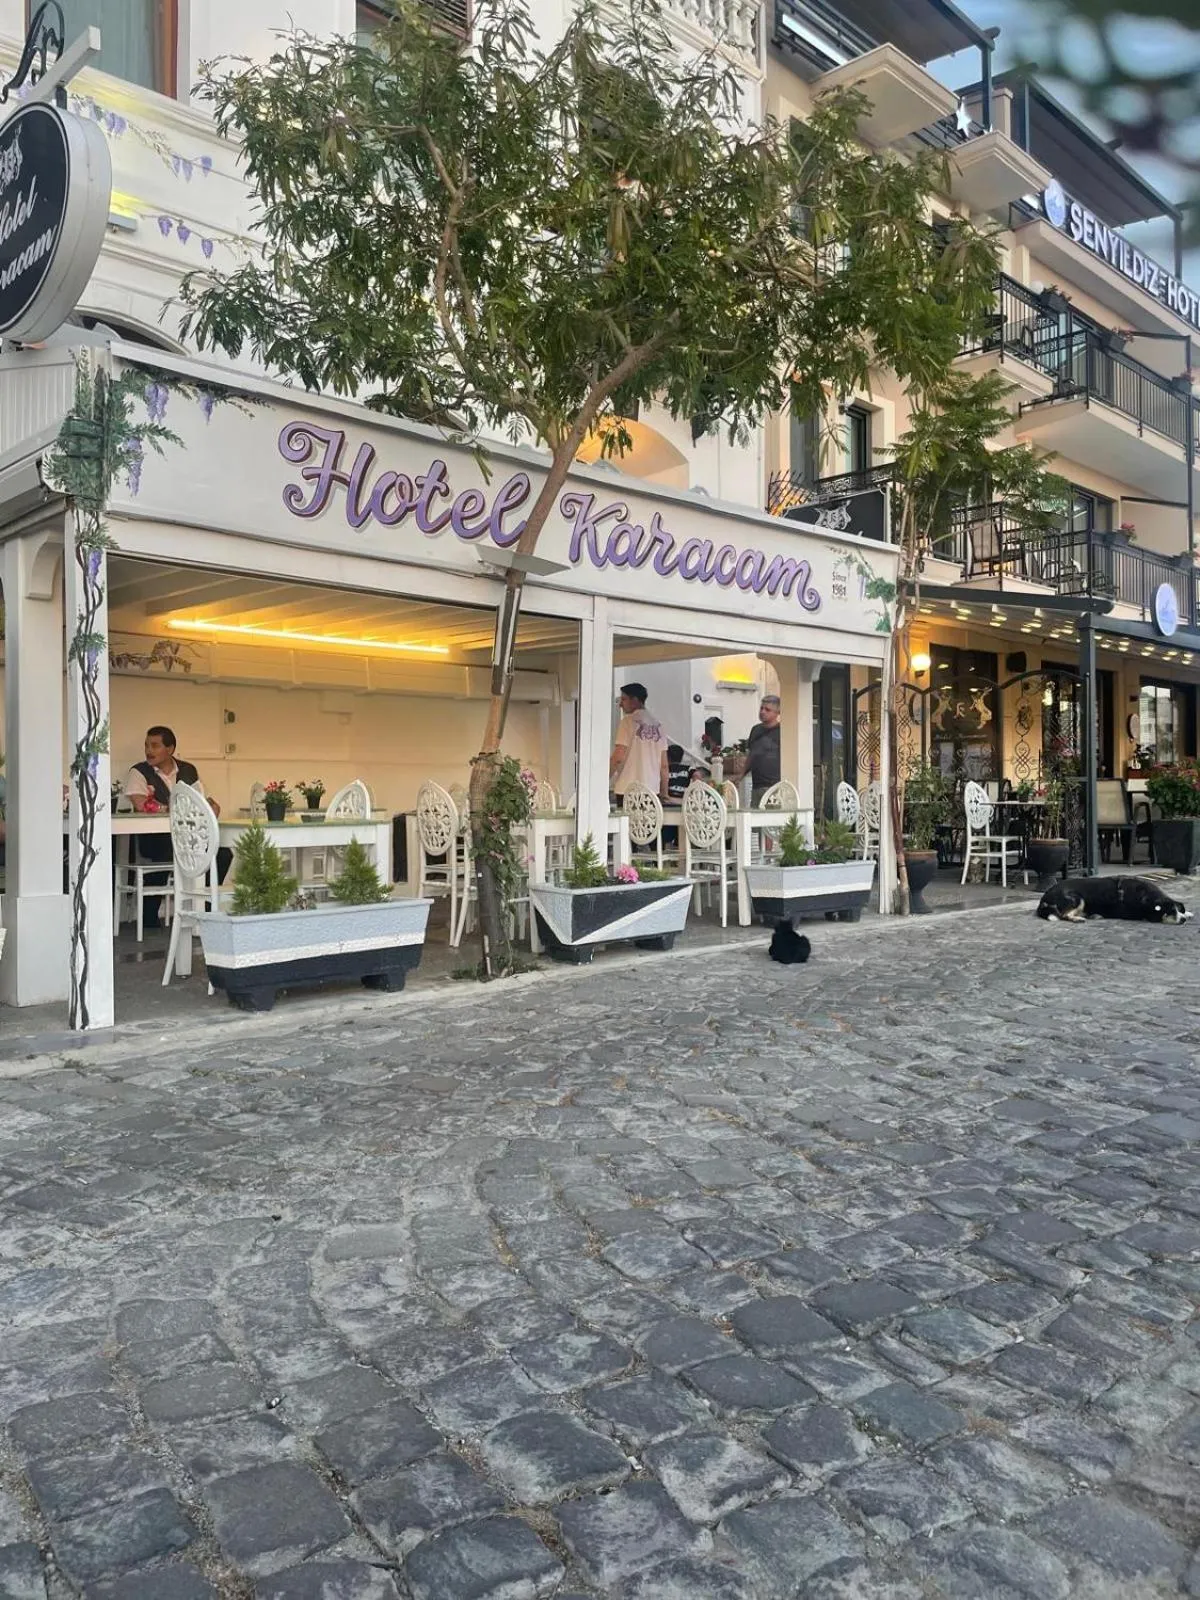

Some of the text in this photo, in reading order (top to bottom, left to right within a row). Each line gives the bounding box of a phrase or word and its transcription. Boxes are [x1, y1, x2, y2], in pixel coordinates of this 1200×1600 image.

[0, 224, 57, 290] racam
[1168, 275, 1200, 328] HOT
[278, 420, 820, 610] Hotel Karacam
